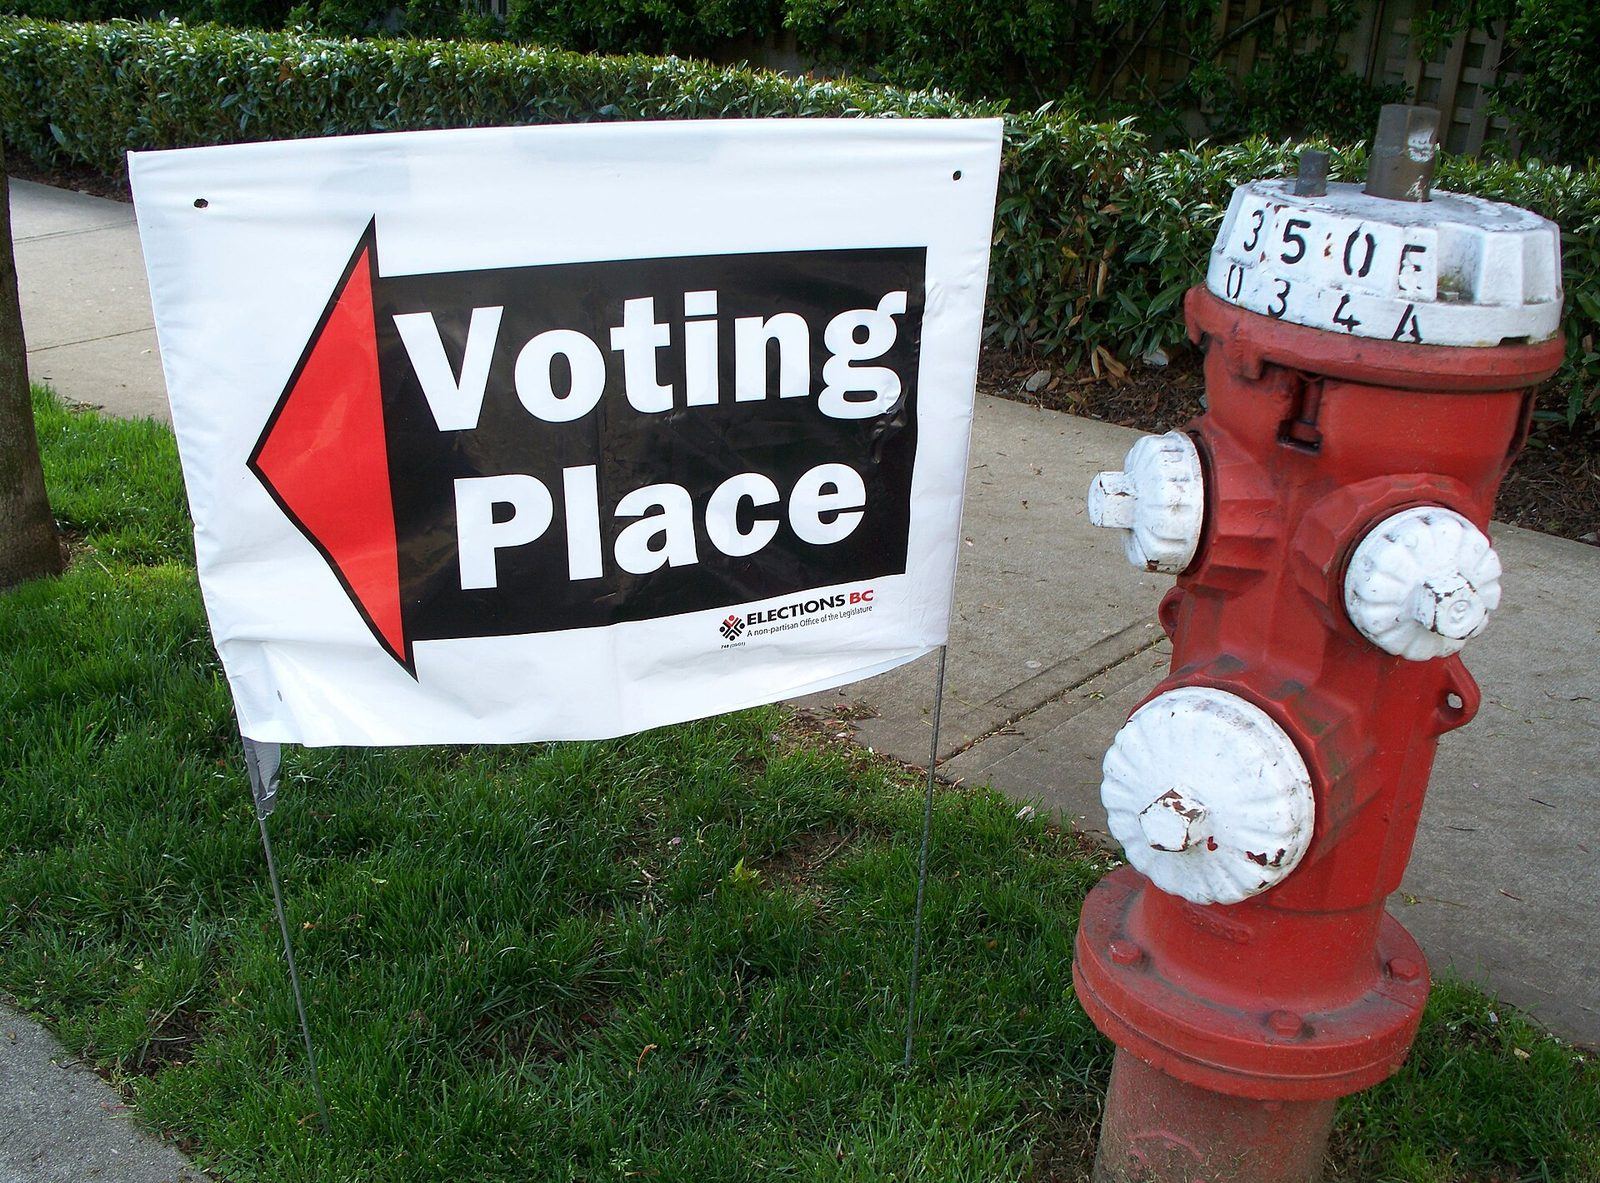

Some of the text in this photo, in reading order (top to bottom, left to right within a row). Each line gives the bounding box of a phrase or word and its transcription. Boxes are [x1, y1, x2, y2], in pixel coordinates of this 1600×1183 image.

[392, 290, 908, 432] Voting
[453, 462, 867, 590] Place
[746, 589, 874, 626] ELECTIONS BC
[746, 605, 873, 637] A non-partisan Office of the Legislature
